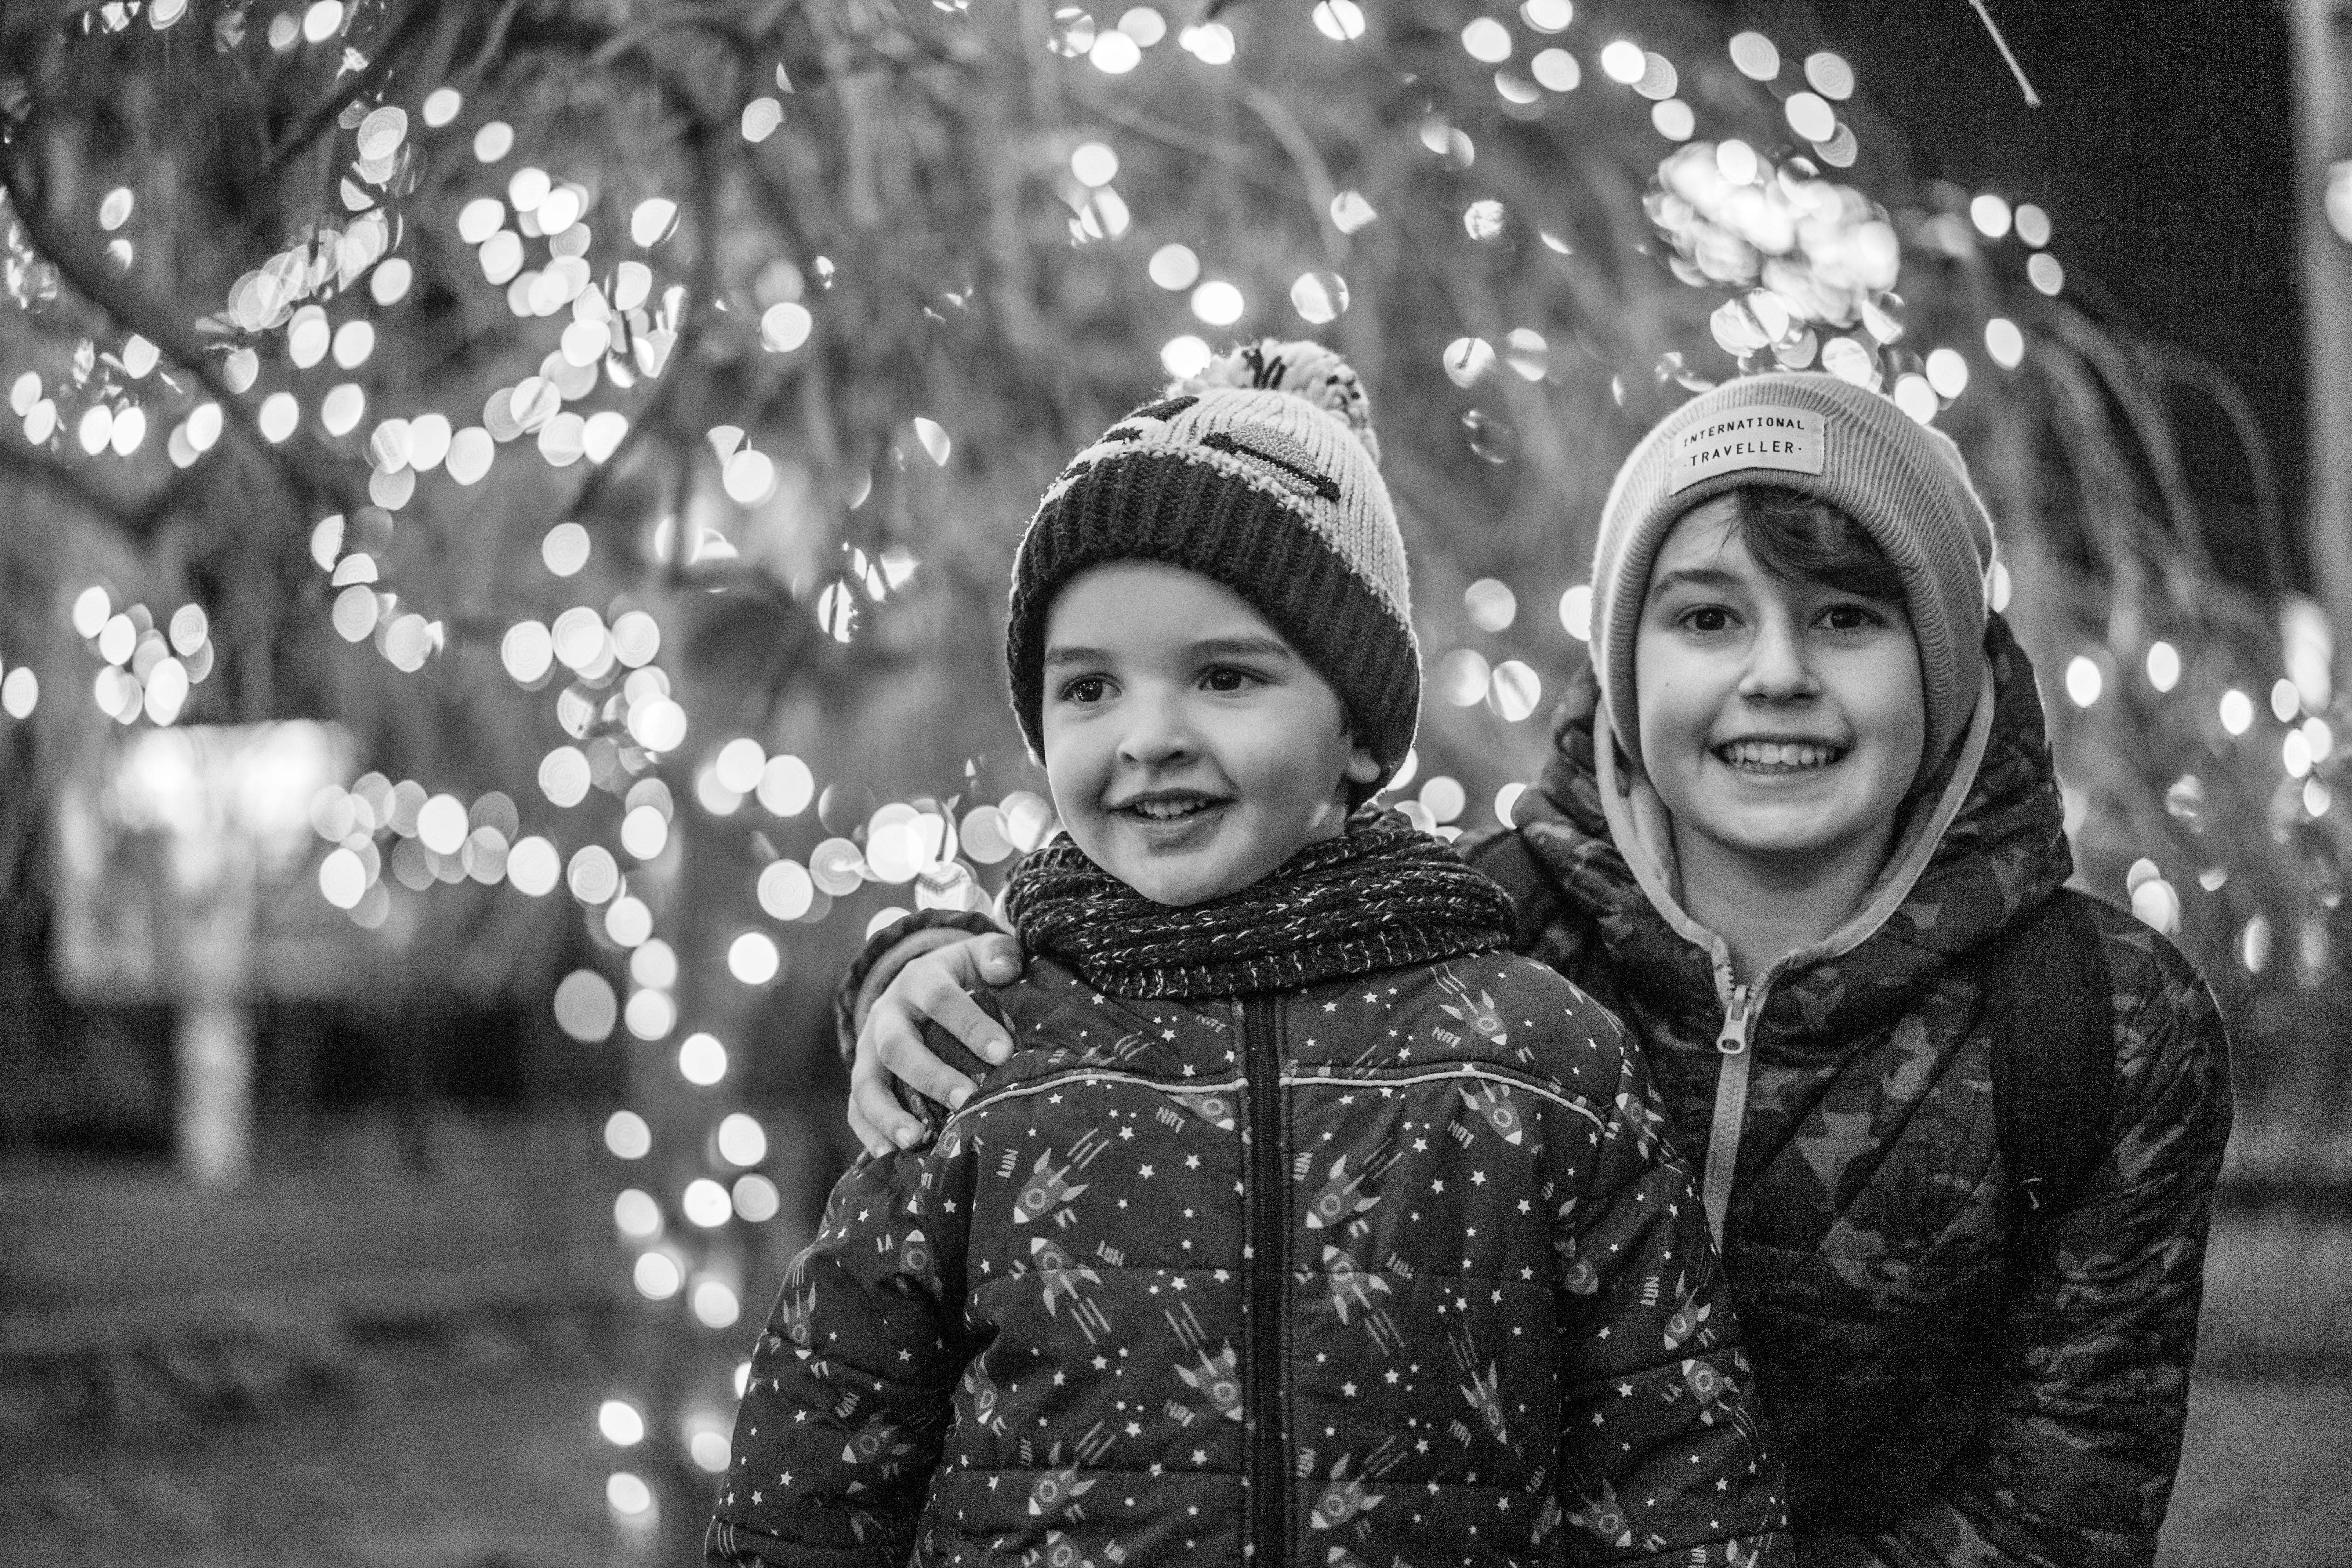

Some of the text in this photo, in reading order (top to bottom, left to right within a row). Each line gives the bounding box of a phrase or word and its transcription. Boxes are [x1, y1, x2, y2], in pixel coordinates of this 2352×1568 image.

[1684, 417, 1804, 447] INTERNATIONAL
[1432, 1027, 1462, 1048] LUN
[1156, 1107, 1185, 1133] LUN
[1448, 1120, 1475, 1149] LUN
[997, 1149, 1018, 1178] LUN
[1293, 1152, 1312, 1181] LUN
[876, 1233, 893, 1254] LA
[1096, 1240, 1124, 1266] LUN
[1640, 1276, 1659, 1306] LUN
[835, 1392, 859, 1418] LUN
[1661, 1383, 1682, 1403] LA
[1165, 1400, 1196, 1427] LUN
